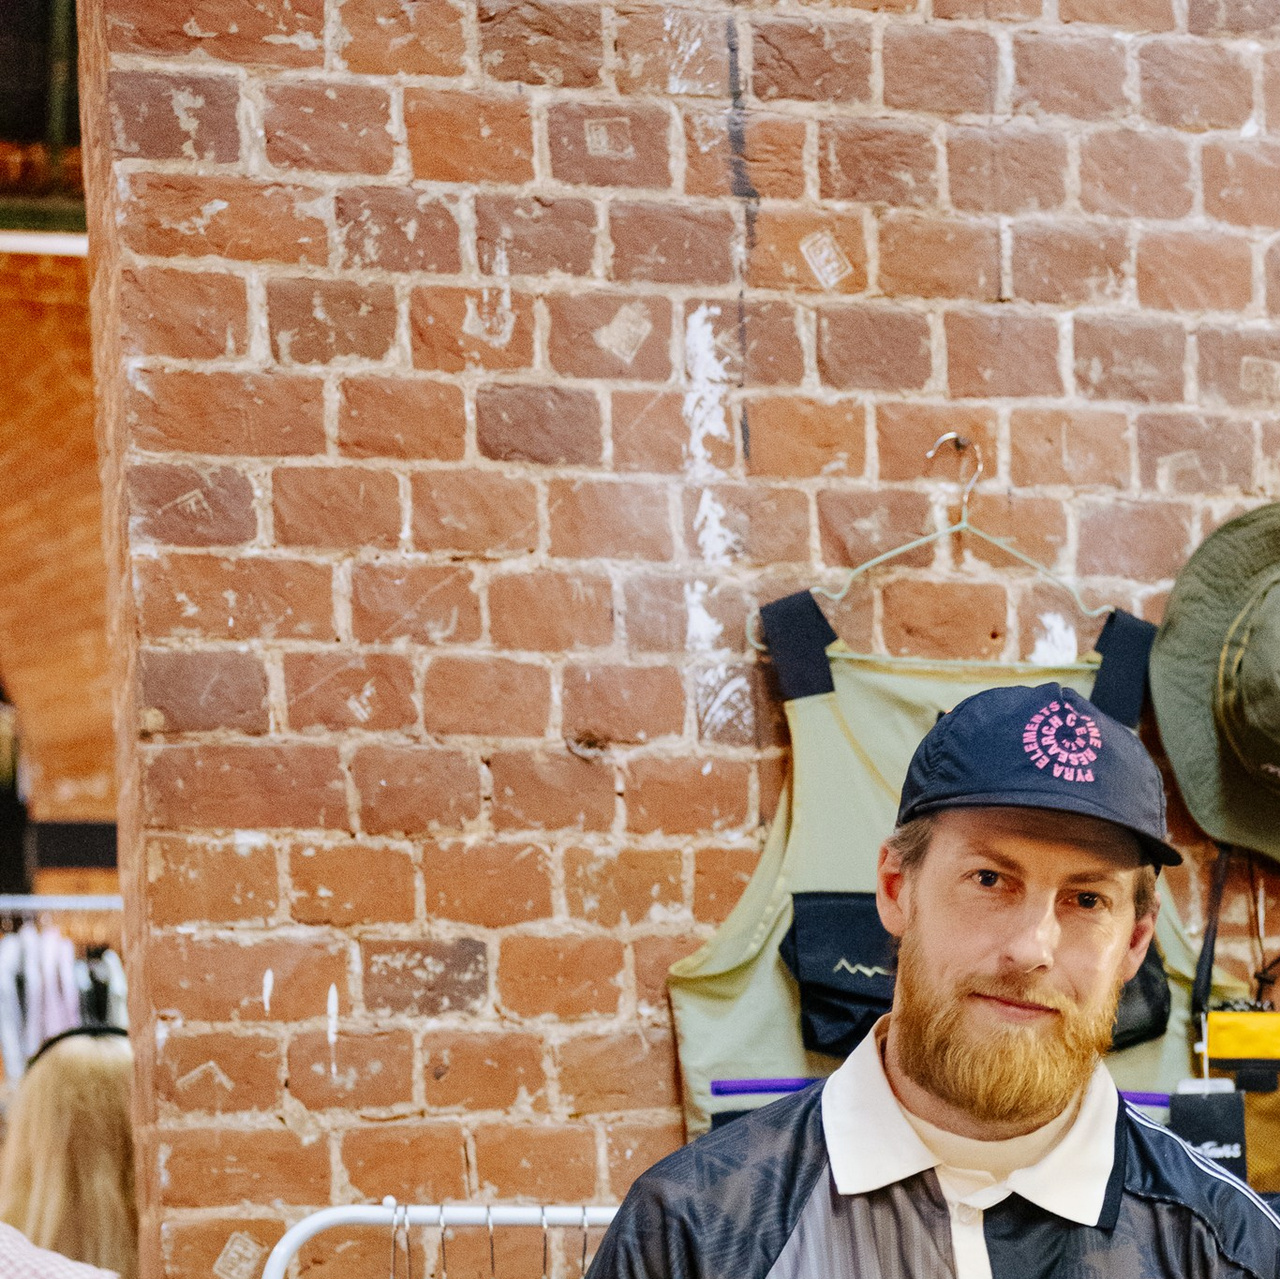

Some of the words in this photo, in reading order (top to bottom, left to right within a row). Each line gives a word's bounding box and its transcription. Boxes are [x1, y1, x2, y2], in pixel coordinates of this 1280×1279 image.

[1022, 701, 1060, 770] ELEMENTS
[1041, 714, 1097, 766] RESEARCH
[1053, 763, 1095, 782] PYRA
